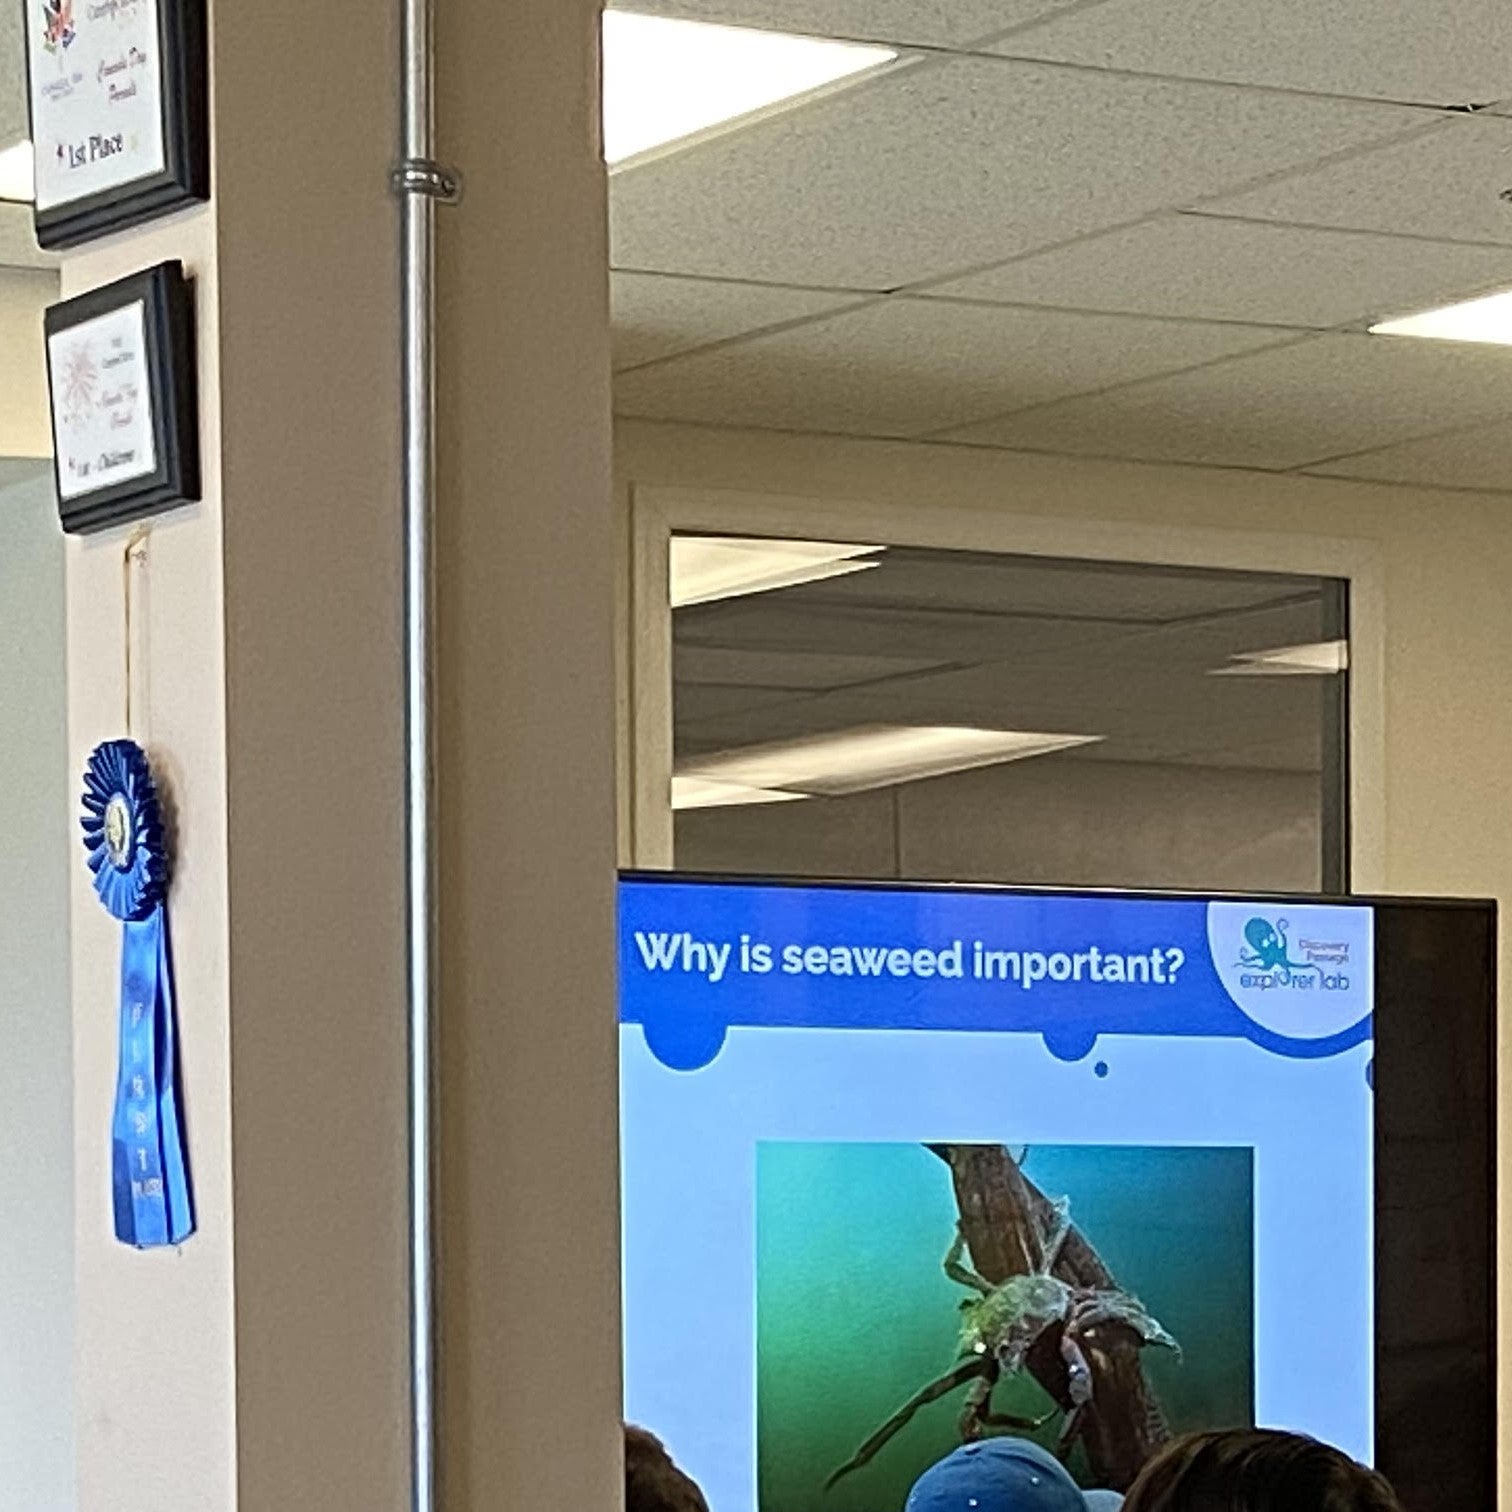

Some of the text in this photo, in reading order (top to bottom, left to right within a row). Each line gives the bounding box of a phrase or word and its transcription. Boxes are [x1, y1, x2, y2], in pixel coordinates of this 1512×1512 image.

[635, 932, 1185, 989] Why is seaweed important?
